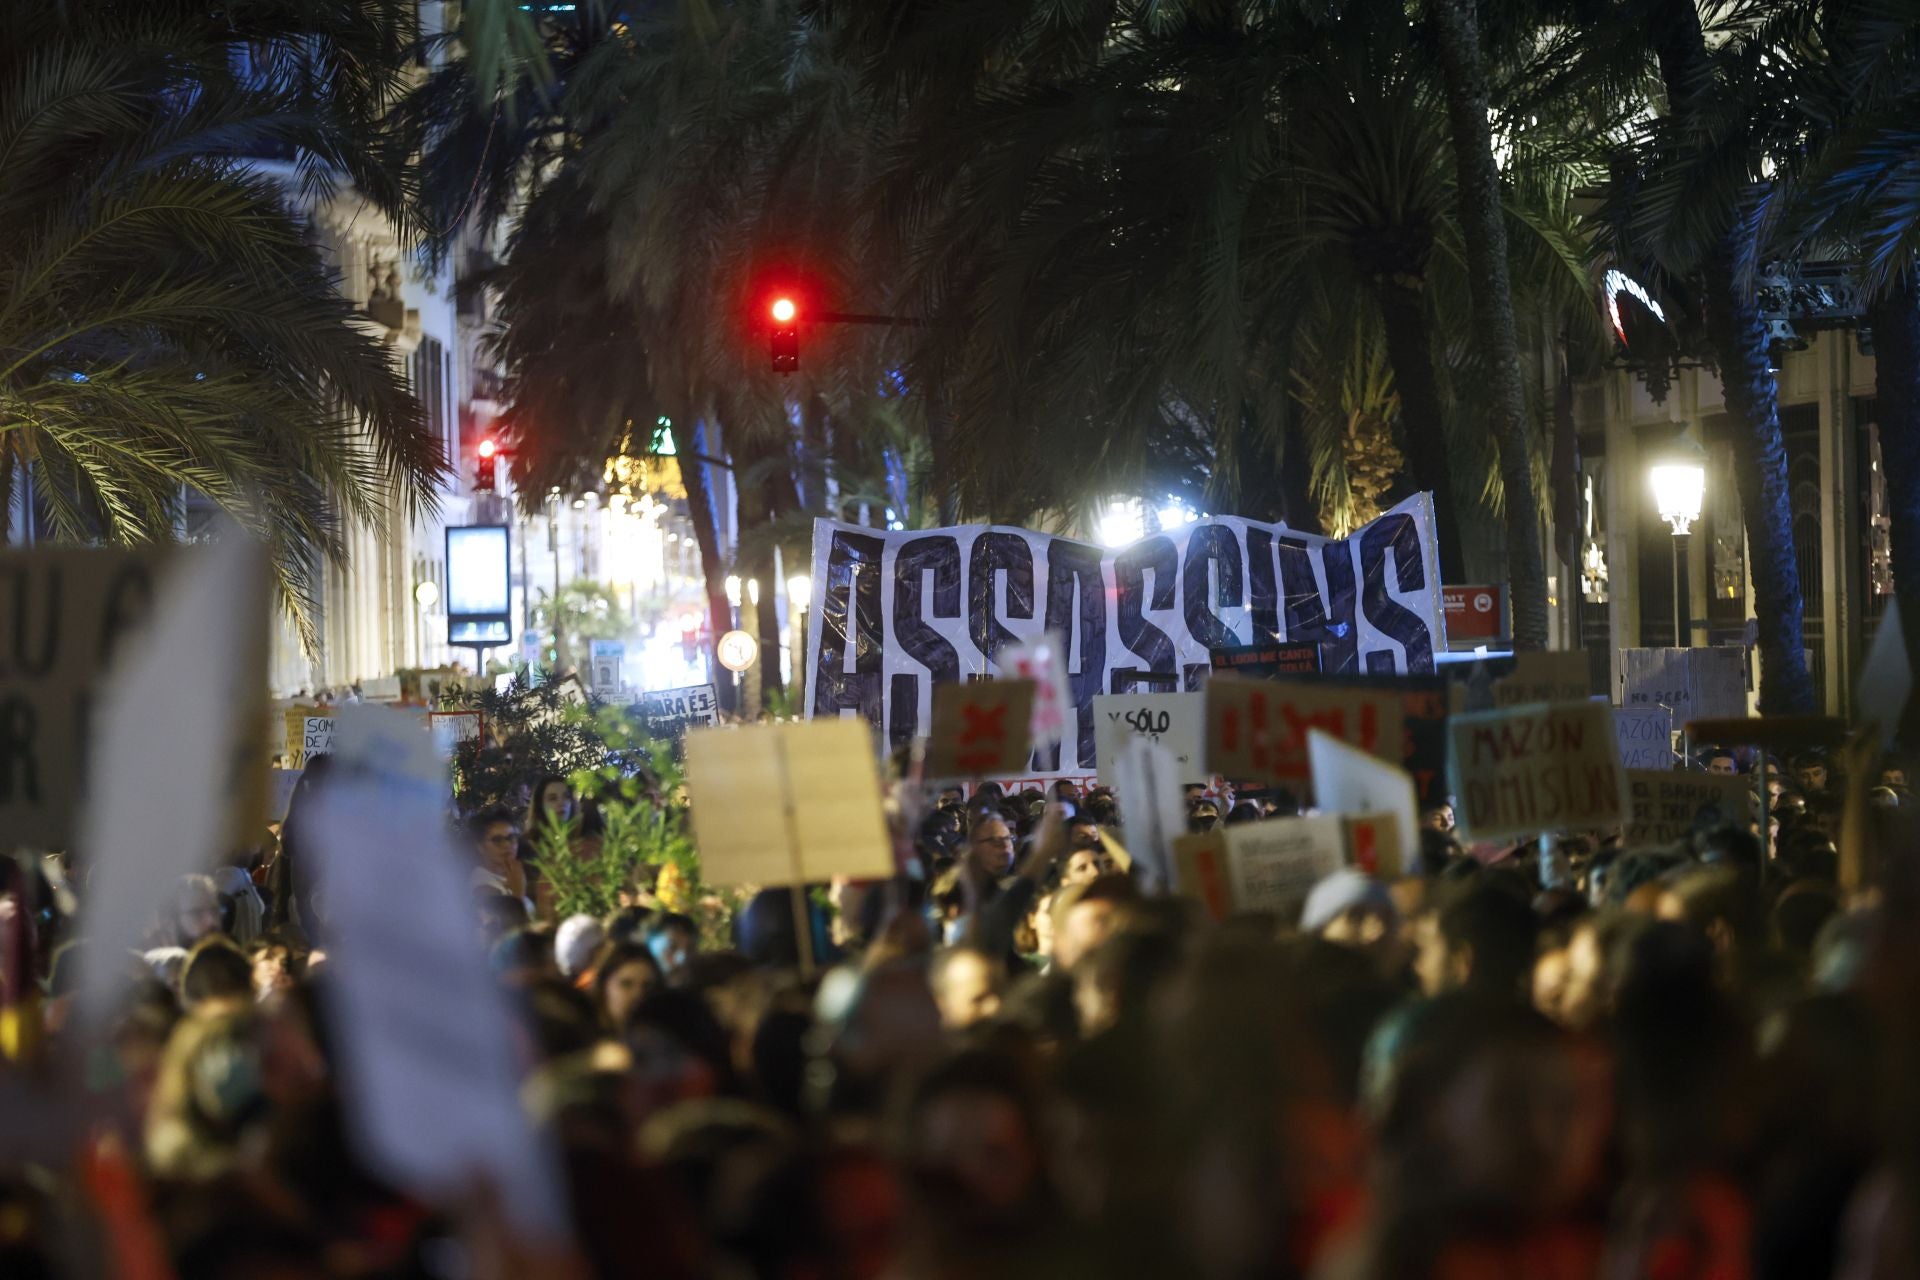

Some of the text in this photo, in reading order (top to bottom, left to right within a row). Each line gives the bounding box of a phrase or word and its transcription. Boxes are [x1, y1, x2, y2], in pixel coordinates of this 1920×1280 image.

[307, 718, 337, 734] SOM
[1125, 707, 1170, 733] SÓLO
[1619, 714, 1666, 741] AZÓN
[306, 736, 322, 748] DE
